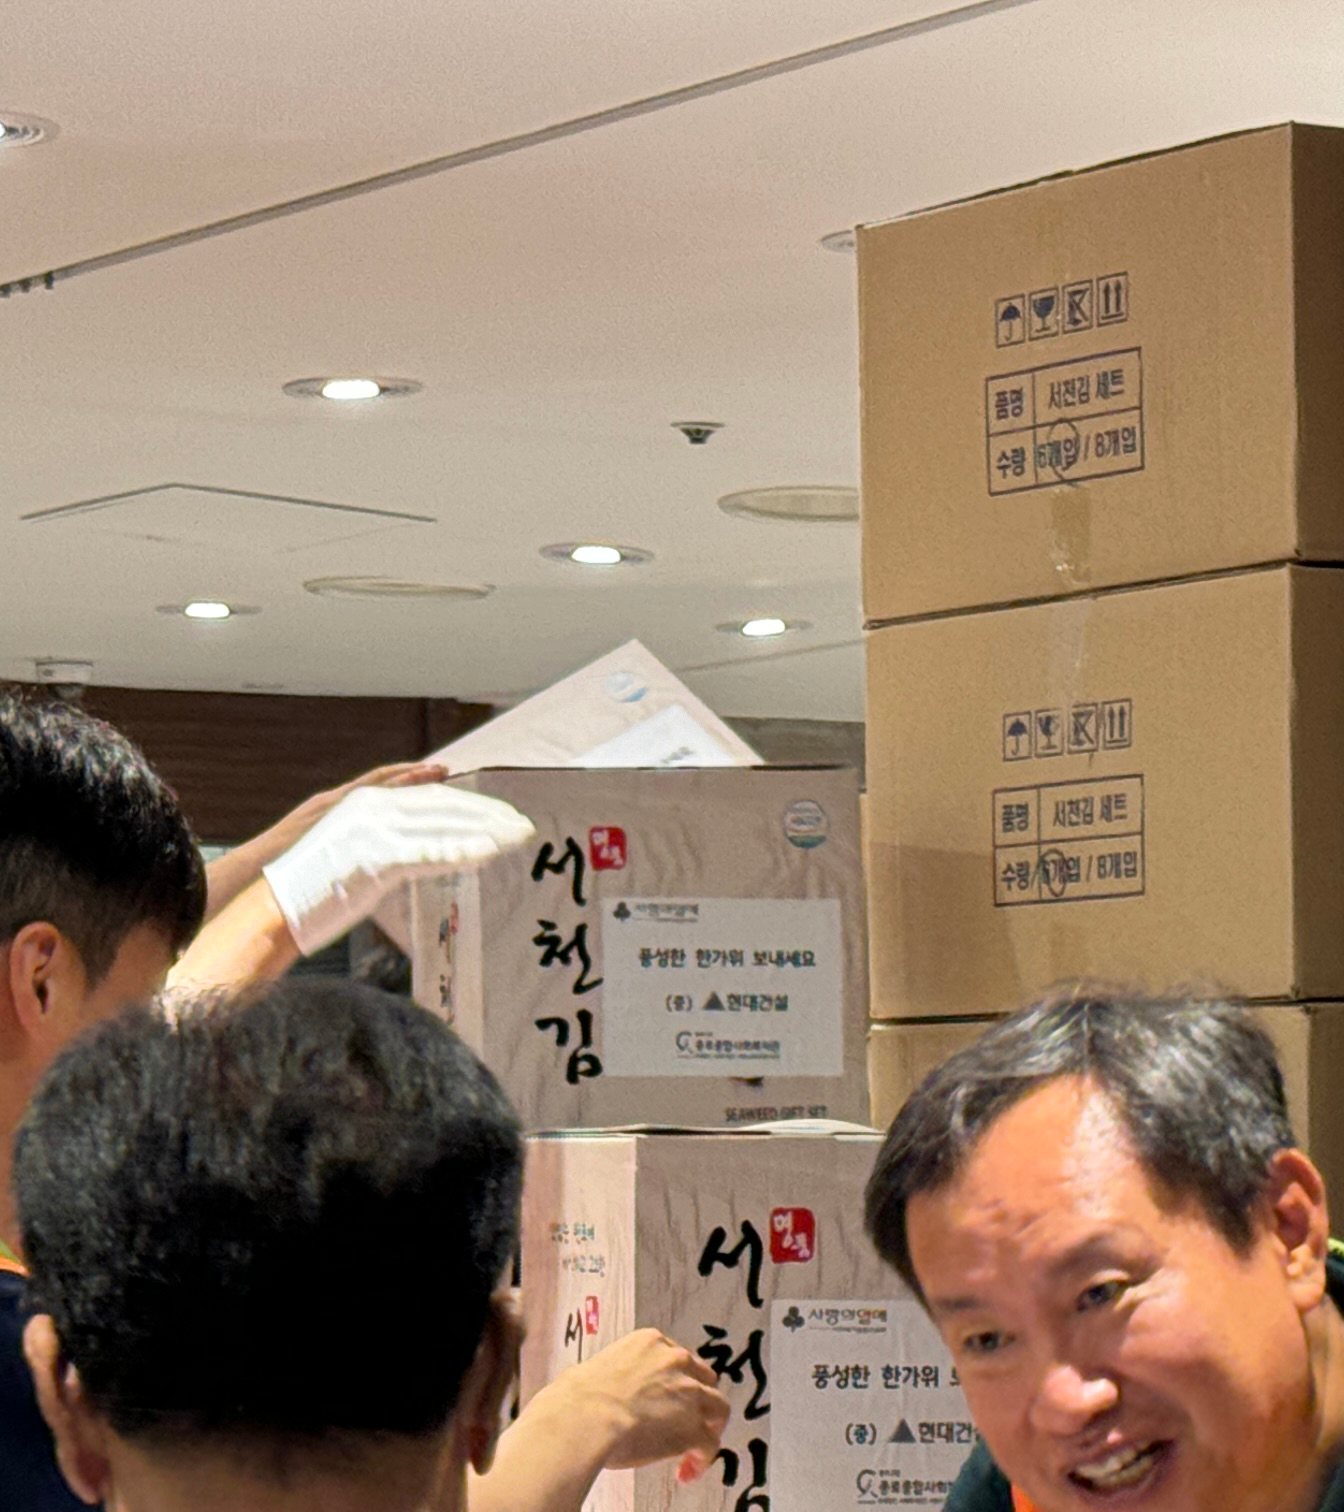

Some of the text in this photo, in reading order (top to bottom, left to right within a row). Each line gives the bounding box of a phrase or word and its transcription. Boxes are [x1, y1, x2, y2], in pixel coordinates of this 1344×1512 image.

[995, 388, 1024, 420] 품명
[1096, 369, 1125, 399] 세트
[996, 447, 1026, 479] 수량
[1095, 426, 1137, 457] 8개입
[1002, 802, 1029, 832] 품명
[1001, 860, 1030, 891] 수량
[532, 836, 604, 1085] 서천김
[639, 947, 686, 968] 풍성한
[696, 947, 744, 968] 한가위
[809, 1307, 887, 1325] 사랑의열매
[812, 1364, 870, 1389] 풍성한
[882, 1364, 939, 1389] 한가위
